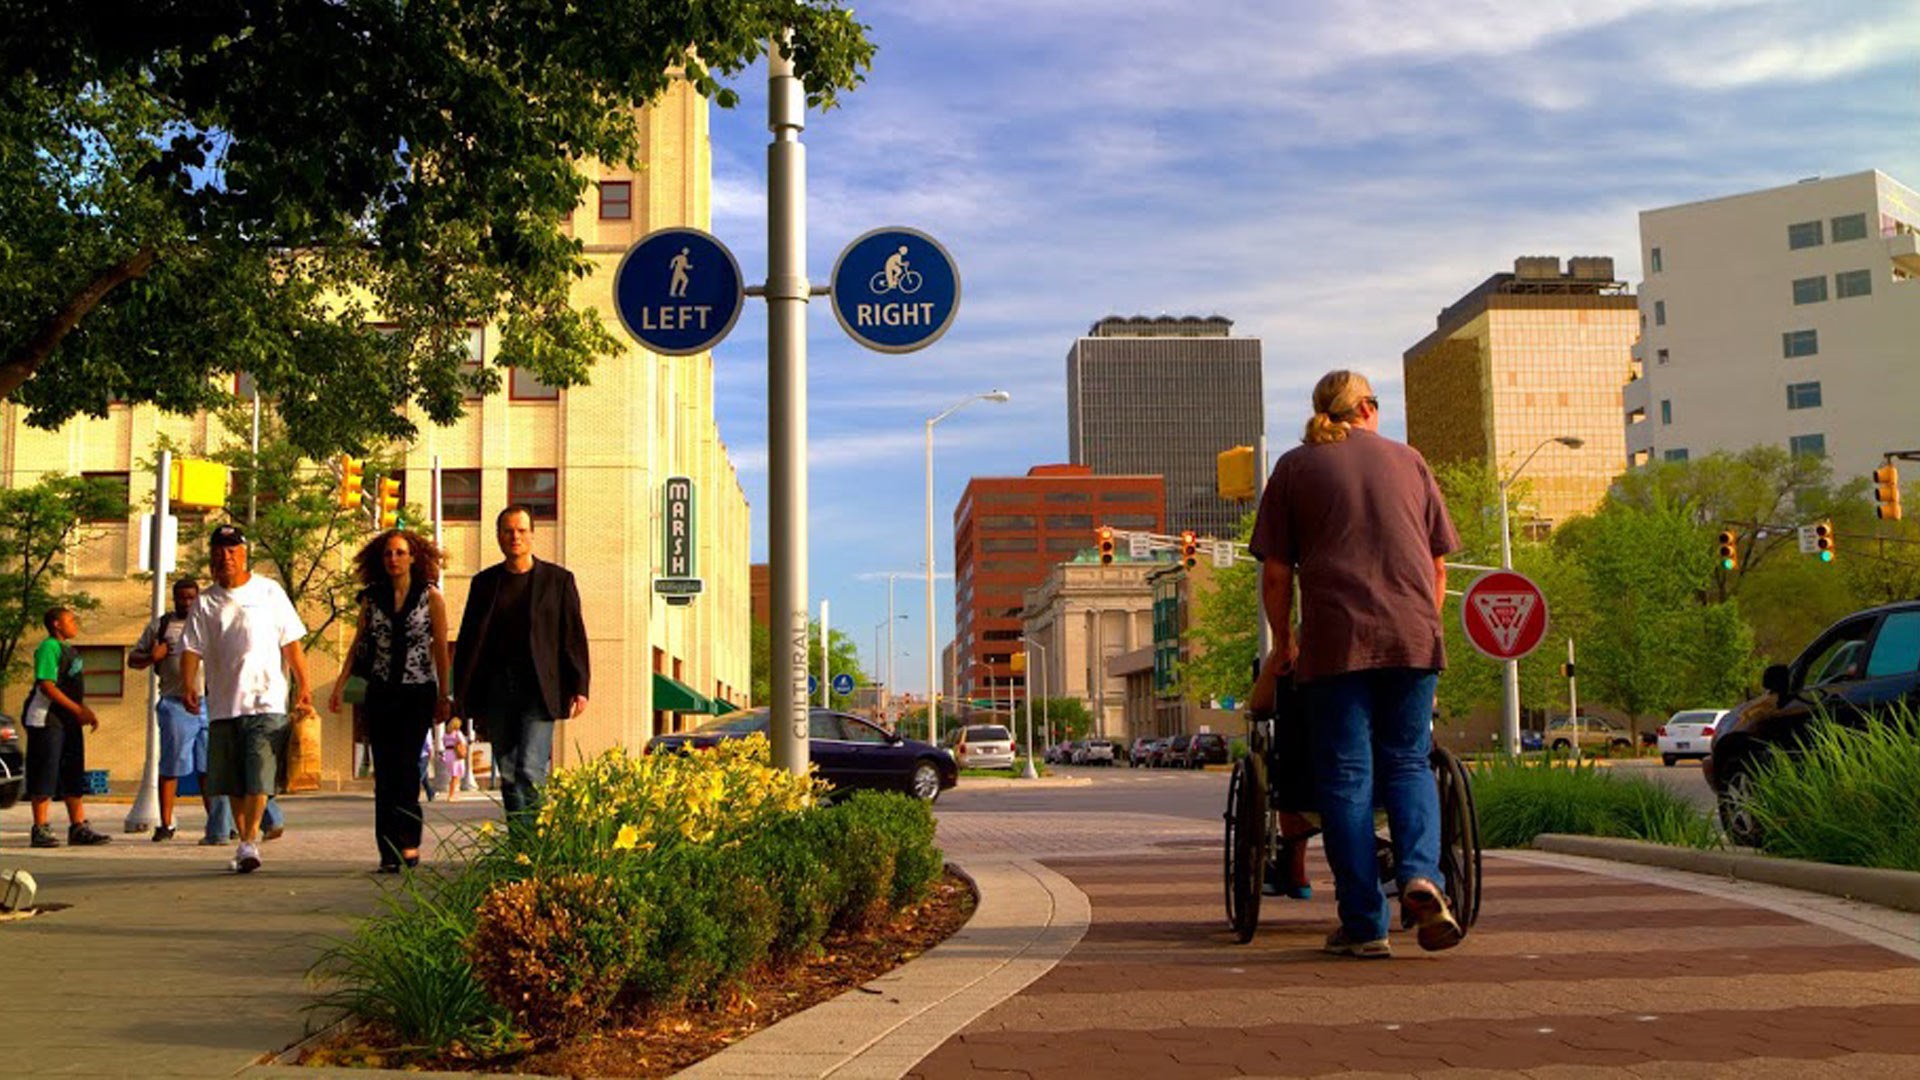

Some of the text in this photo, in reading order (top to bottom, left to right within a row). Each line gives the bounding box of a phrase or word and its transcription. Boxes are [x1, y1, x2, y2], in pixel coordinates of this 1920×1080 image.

[642, 305, 712, 330] LEFT
[857, 302, 935, 327] RIGHT
[669, 483, 688, 573] MARSH
[792, 622, 807, 741] CULTURAL
